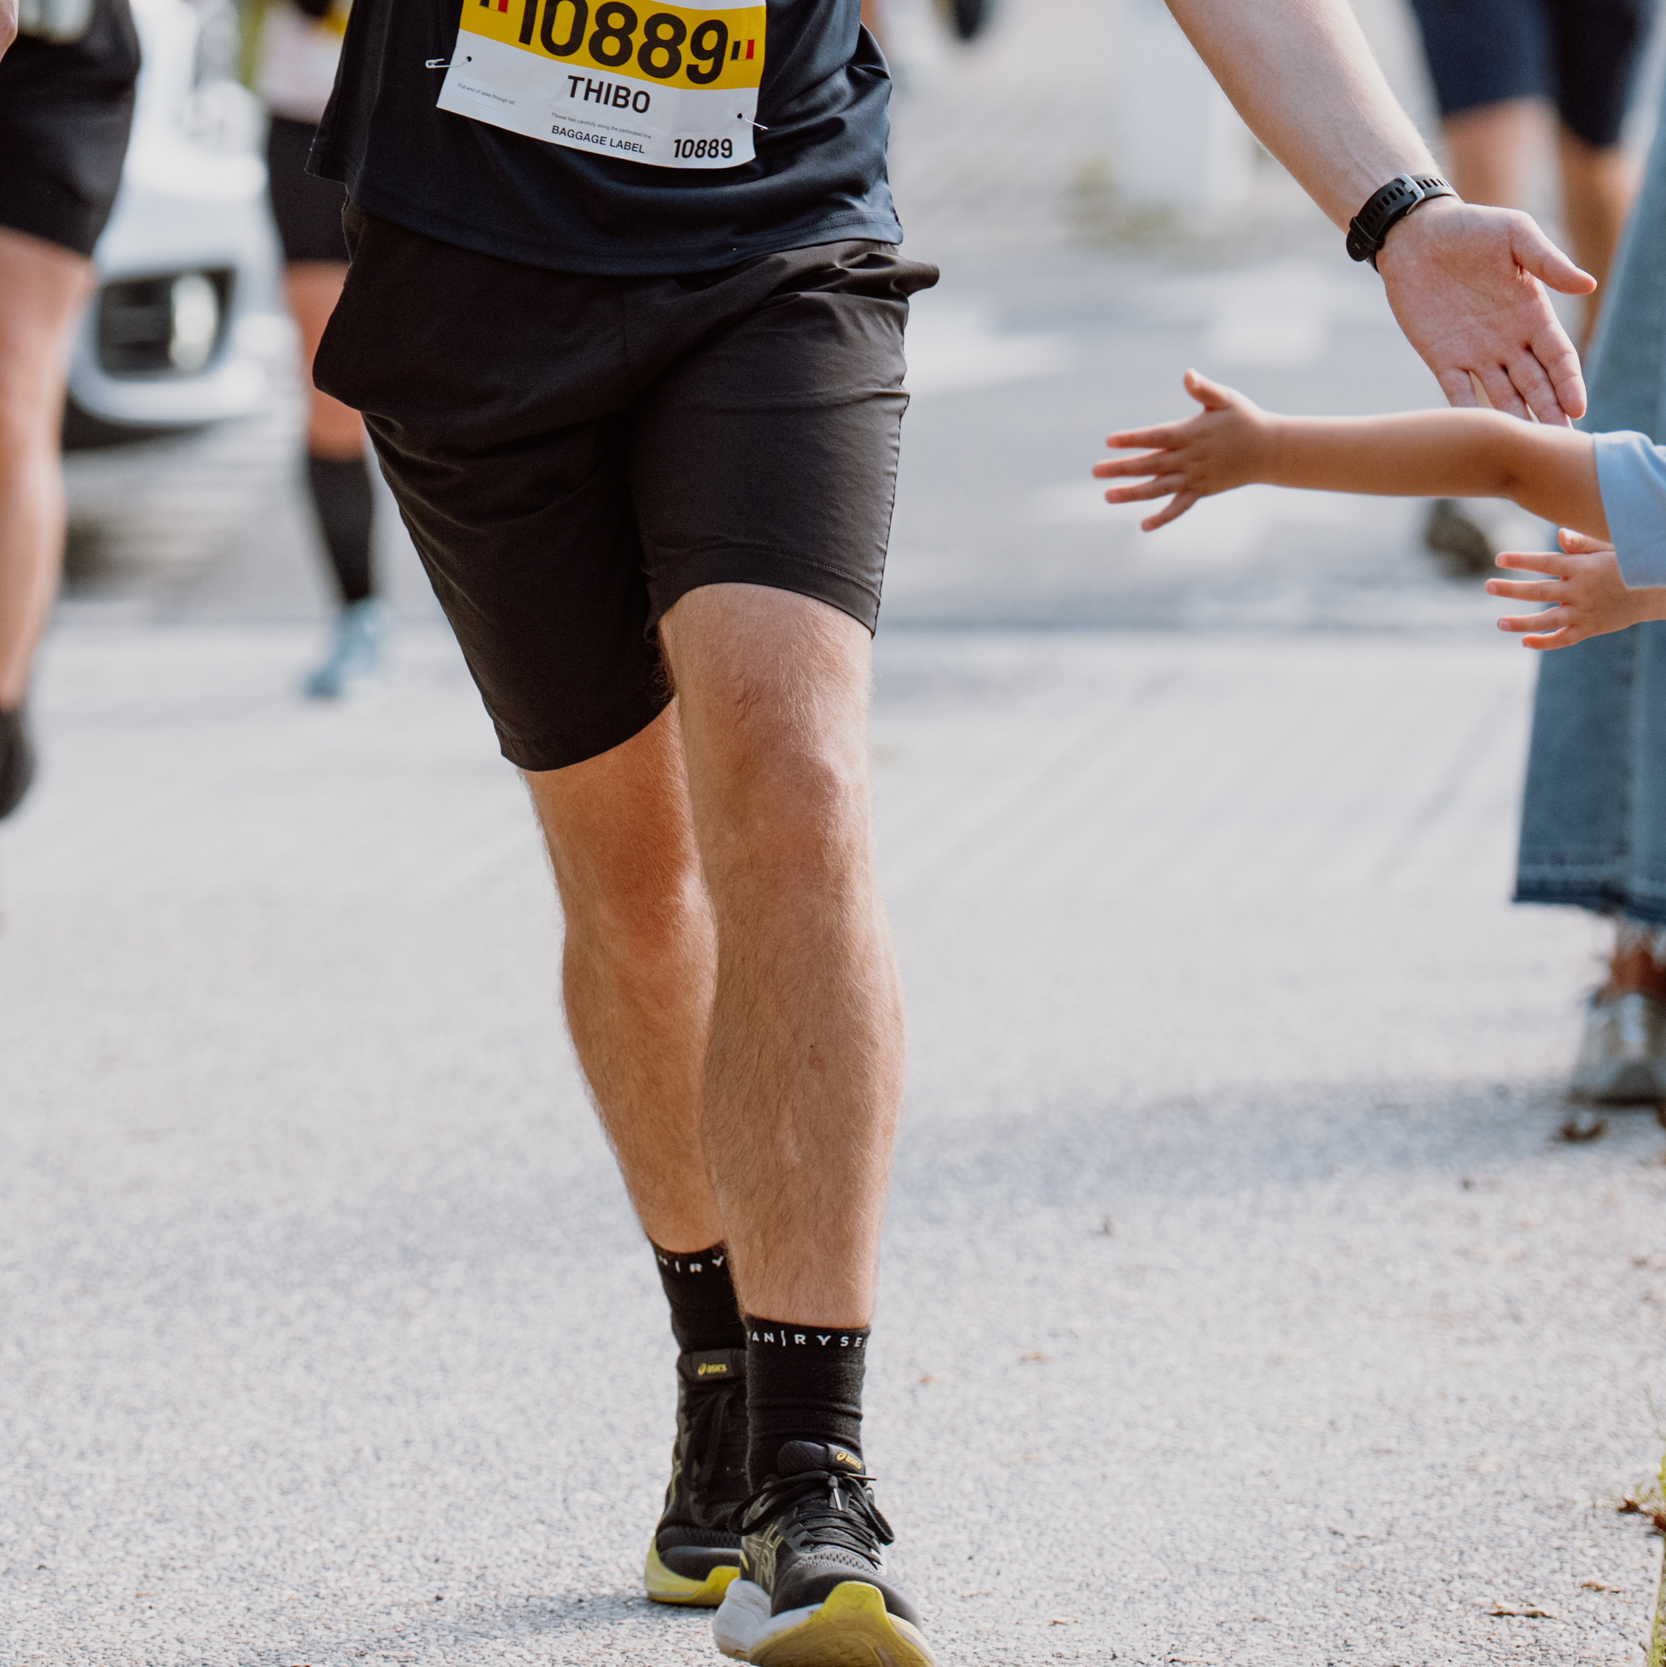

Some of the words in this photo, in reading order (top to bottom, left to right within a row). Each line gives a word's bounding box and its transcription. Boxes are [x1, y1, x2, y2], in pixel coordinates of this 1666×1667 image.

[492, 94, 508, 103] through
[568, 75, 651, 114] THIBO
[551, 112, 567, 120] Please
[577, 119, 596, 127] carefully
[619, 128, 642, 137] perforated
[551, 125, 607, 145] BAGGAGE
[609, 138, 645, 154] LABEL
[673, 138, 733, 159] 10889
